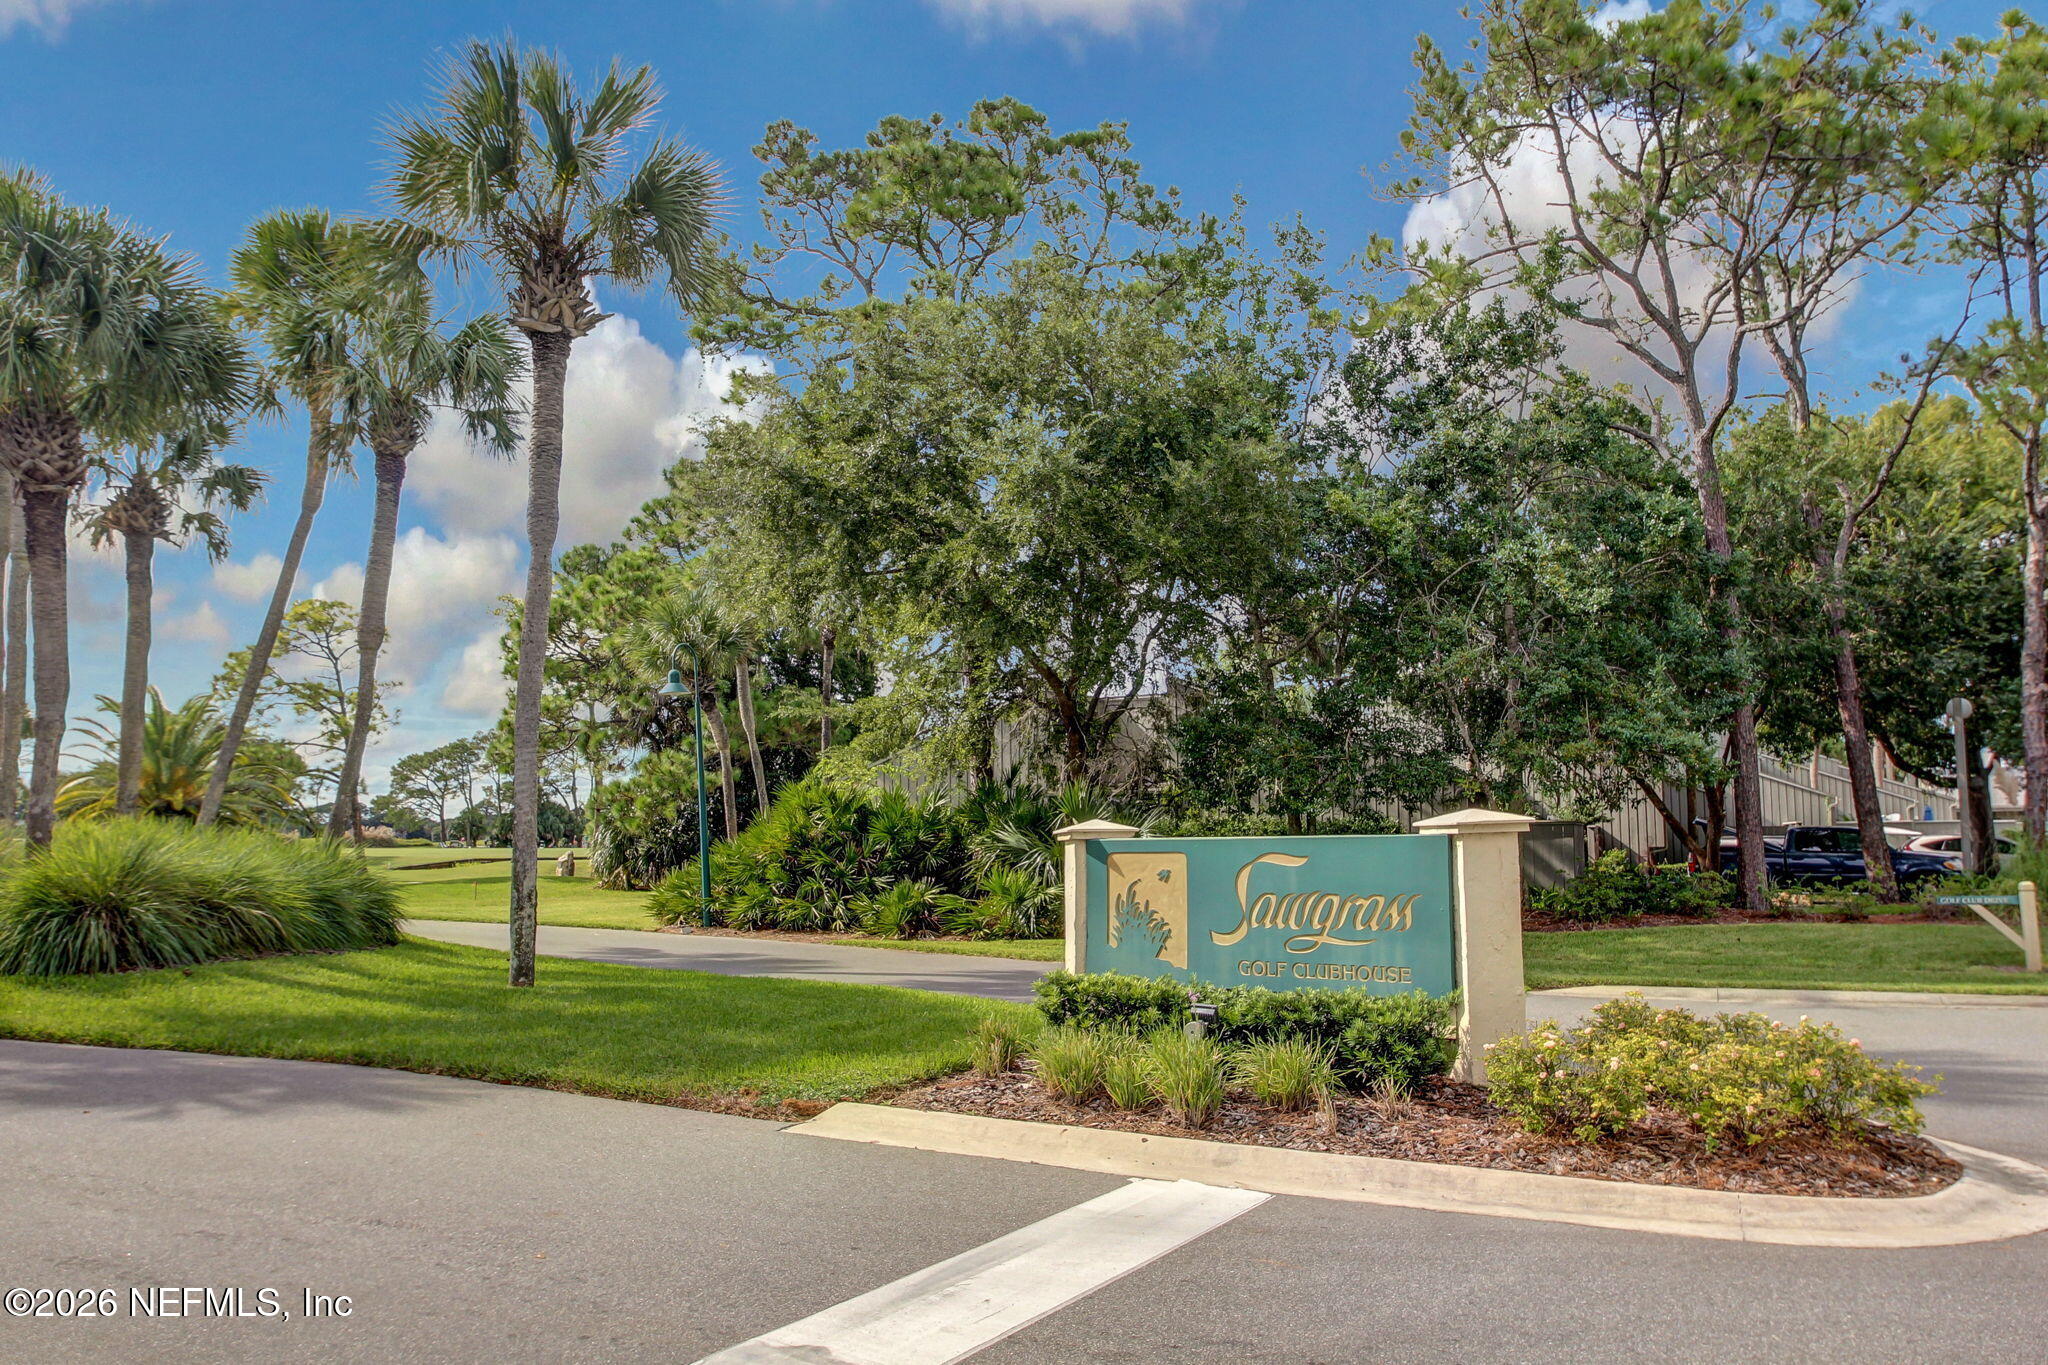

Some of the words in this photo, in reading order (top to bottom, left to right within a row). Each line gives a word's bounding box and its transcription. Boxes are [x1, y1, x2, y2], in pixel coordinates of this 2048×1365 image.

[1209, 852, 1421, 954] Sawgrass
[1940, 896, 1961, 904] GOLF
[1962, 896, 1983, 904] CLUB
[1984, 896, 2008, 904] DRIVE
[1238, 960, 1288, 978] GOLF
[1292, 961, 1412, 984] CLUBHOUSE
